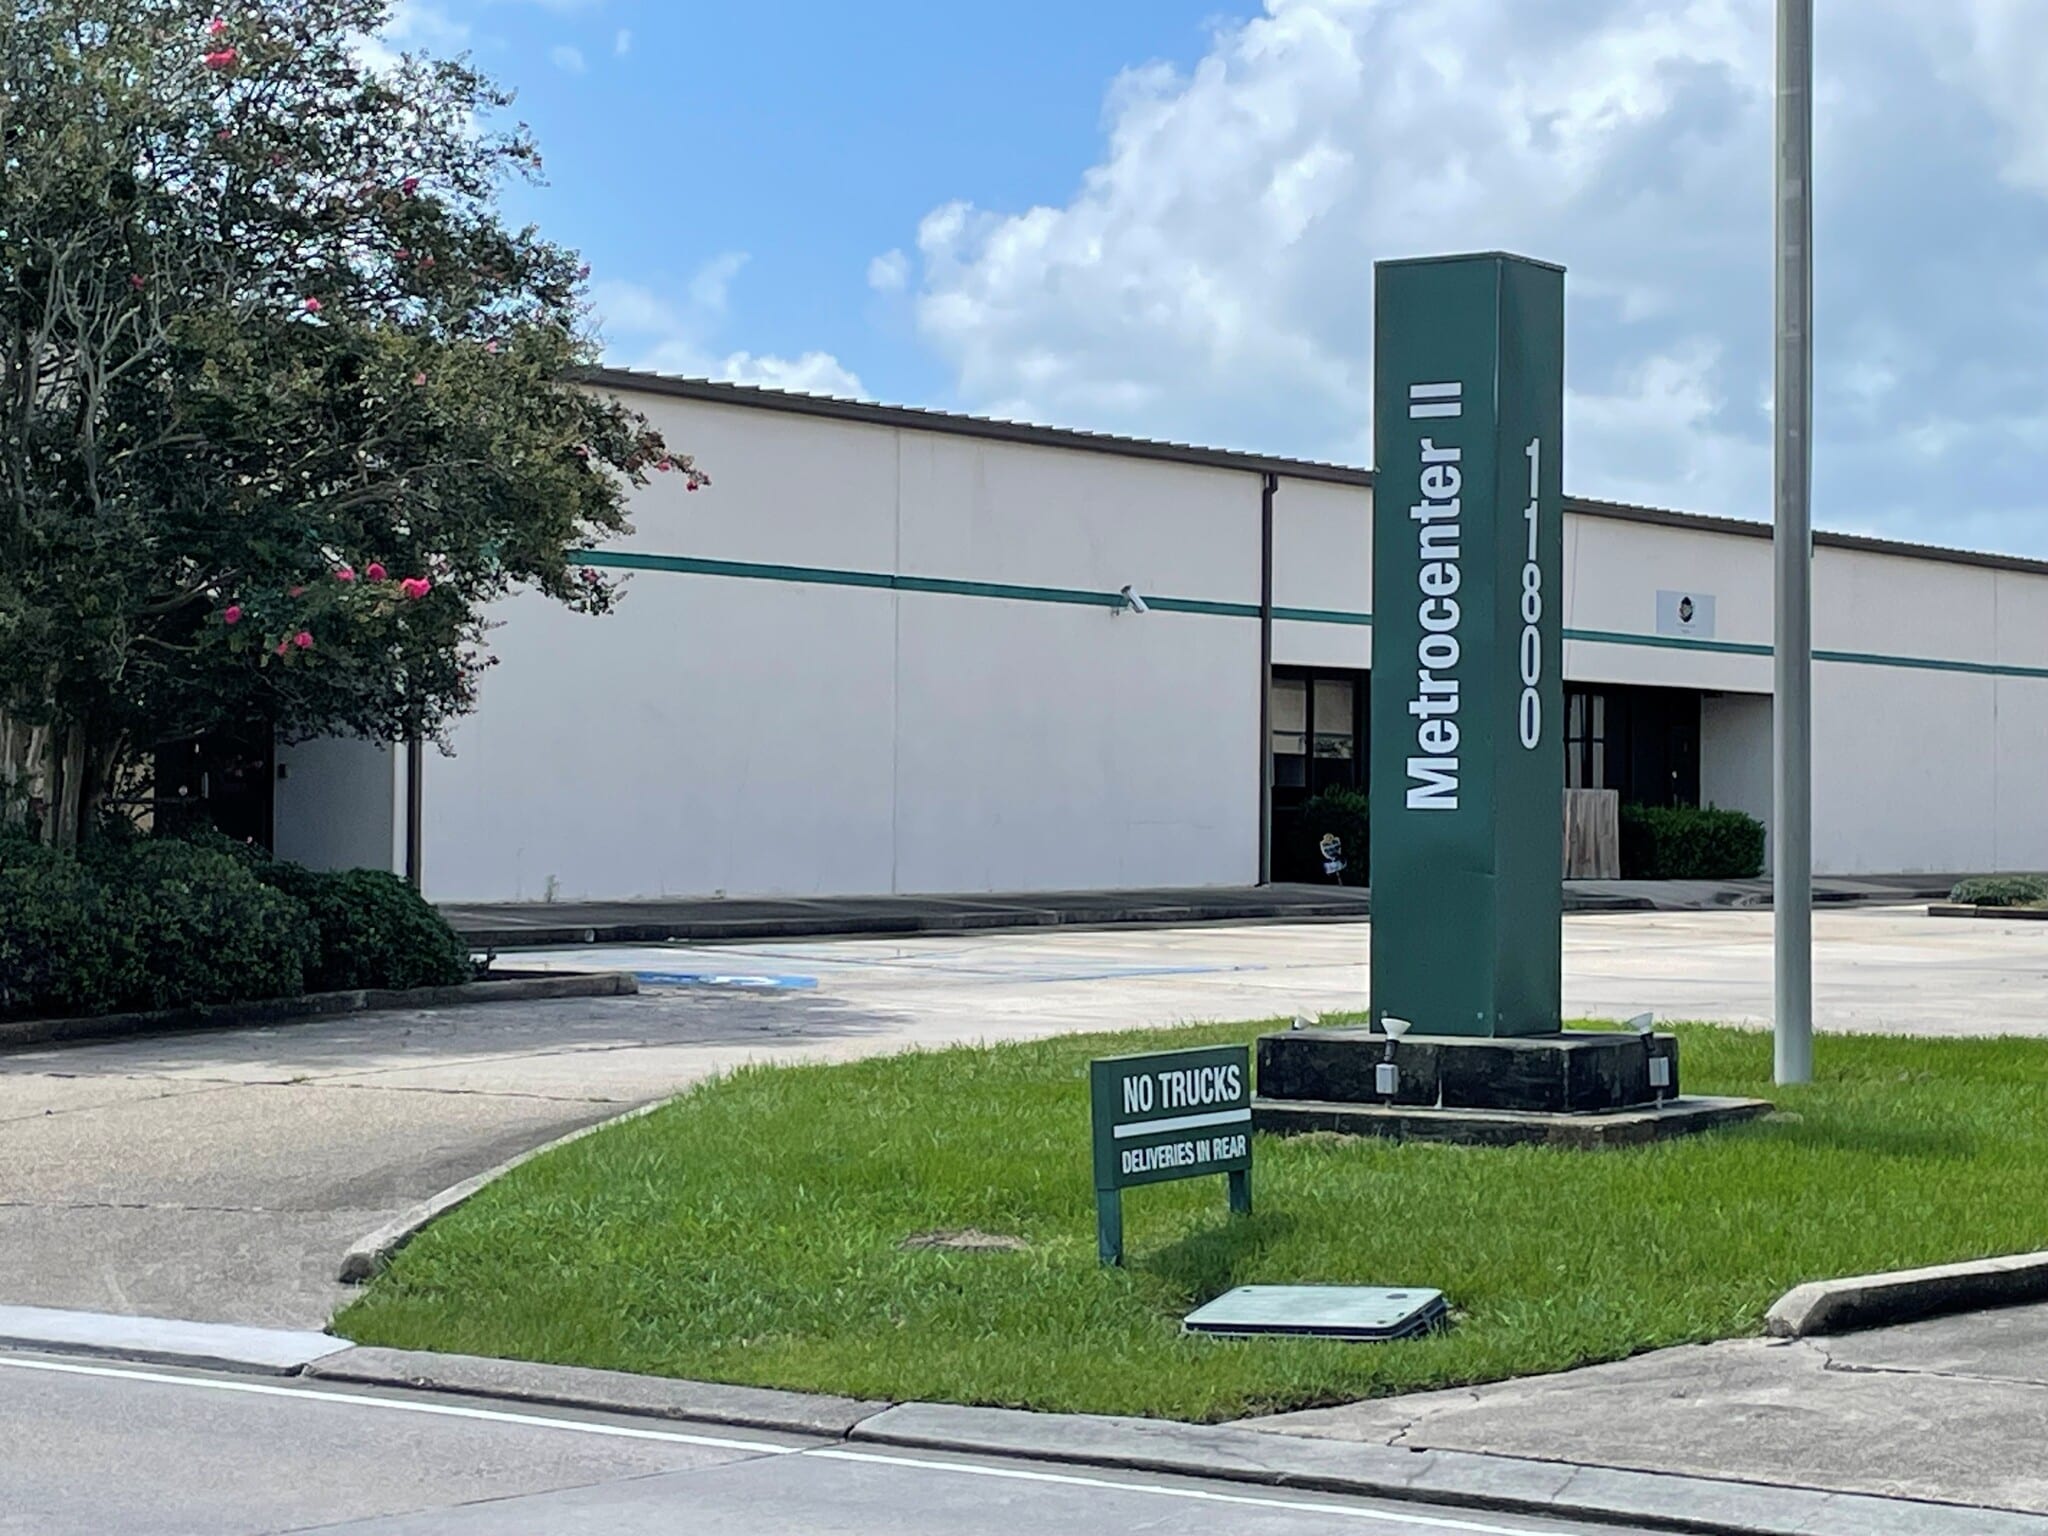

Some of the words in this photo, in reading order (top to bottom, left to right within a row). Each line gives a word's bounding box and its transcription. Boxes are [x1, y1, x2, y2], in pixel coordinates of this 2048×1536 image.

[1409, 382, 1462, 418] II
[1519, 437, 1542, 750] 11800
[1406, 437, 1461, 809] Metrocenter
[1123, 1074, 1154, 1114] NO
[1158, 1064, 1242, 1109] TRUCKS
[1121, 1141, 1195, 1174] DELIVERIES
[1196, 1139, 1211, 1163] IN
[1212, 1134, 1247, 1161] REAR
